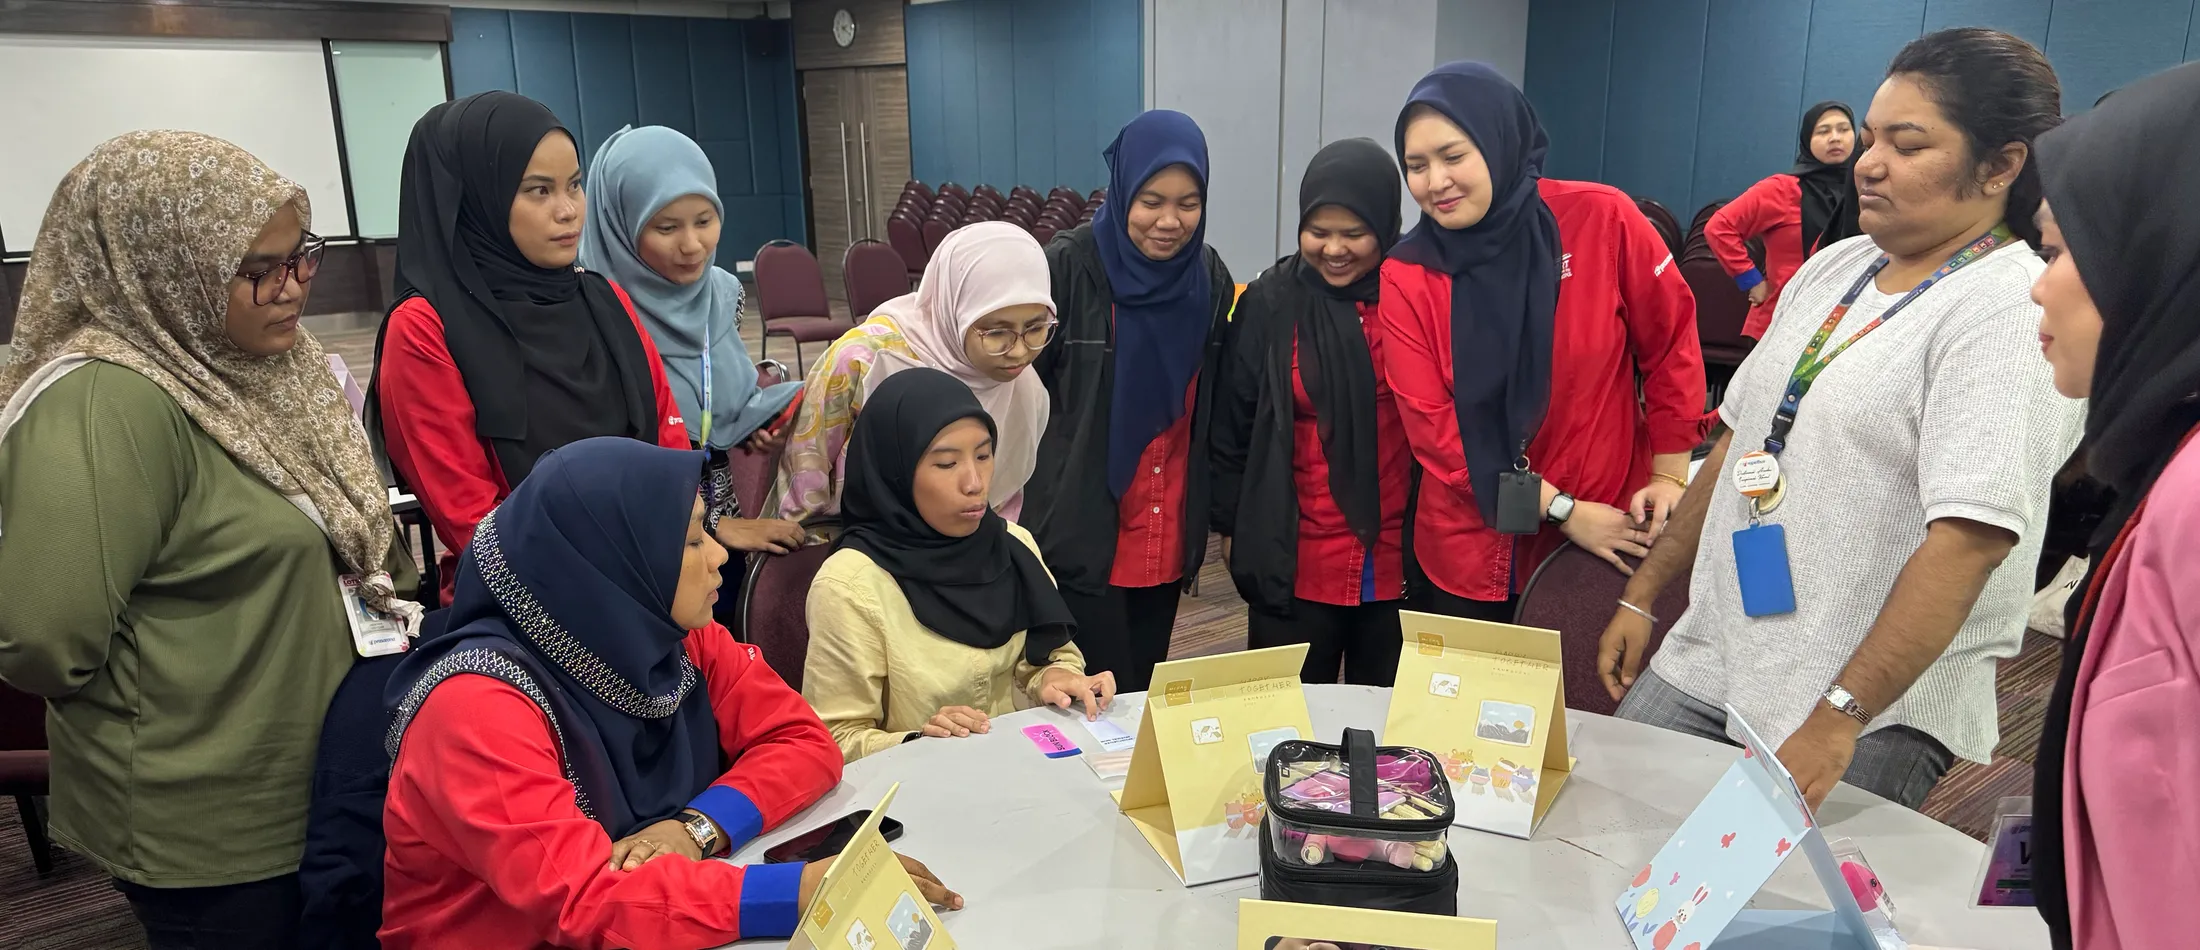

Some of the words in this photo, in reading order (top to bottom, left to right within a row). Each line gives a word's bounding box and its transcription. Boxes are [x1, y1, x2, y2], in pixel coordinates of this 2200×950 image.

[1492, 656, 1550, 671] TOGETHER
[1239, 680, 1293, 695] TOGETHER
[851, 839, 880, 876] TOGETHER
